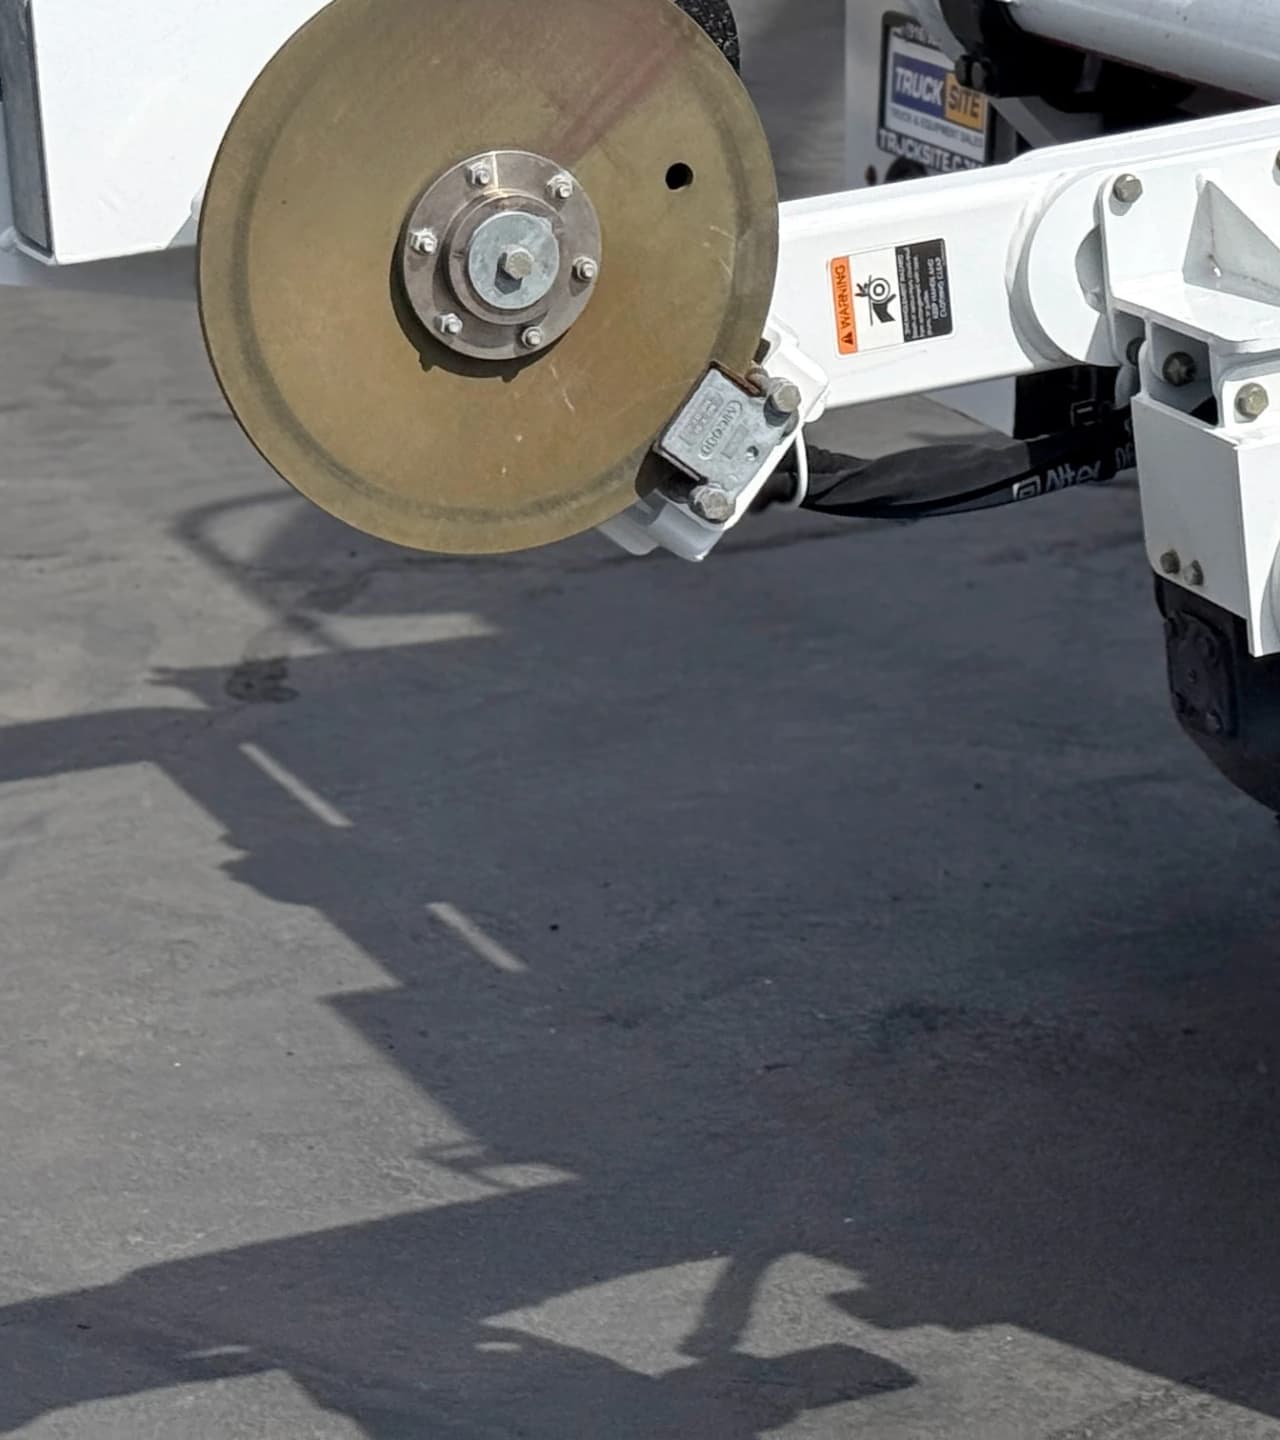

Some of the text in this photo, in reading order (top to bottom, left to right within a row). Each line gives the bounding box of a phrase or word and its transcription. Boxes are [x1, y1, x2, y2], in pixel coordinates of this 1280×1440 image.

[895, 66, 980, 118] TRUCK SITE
[834, 263, 850, 330] WARNING
